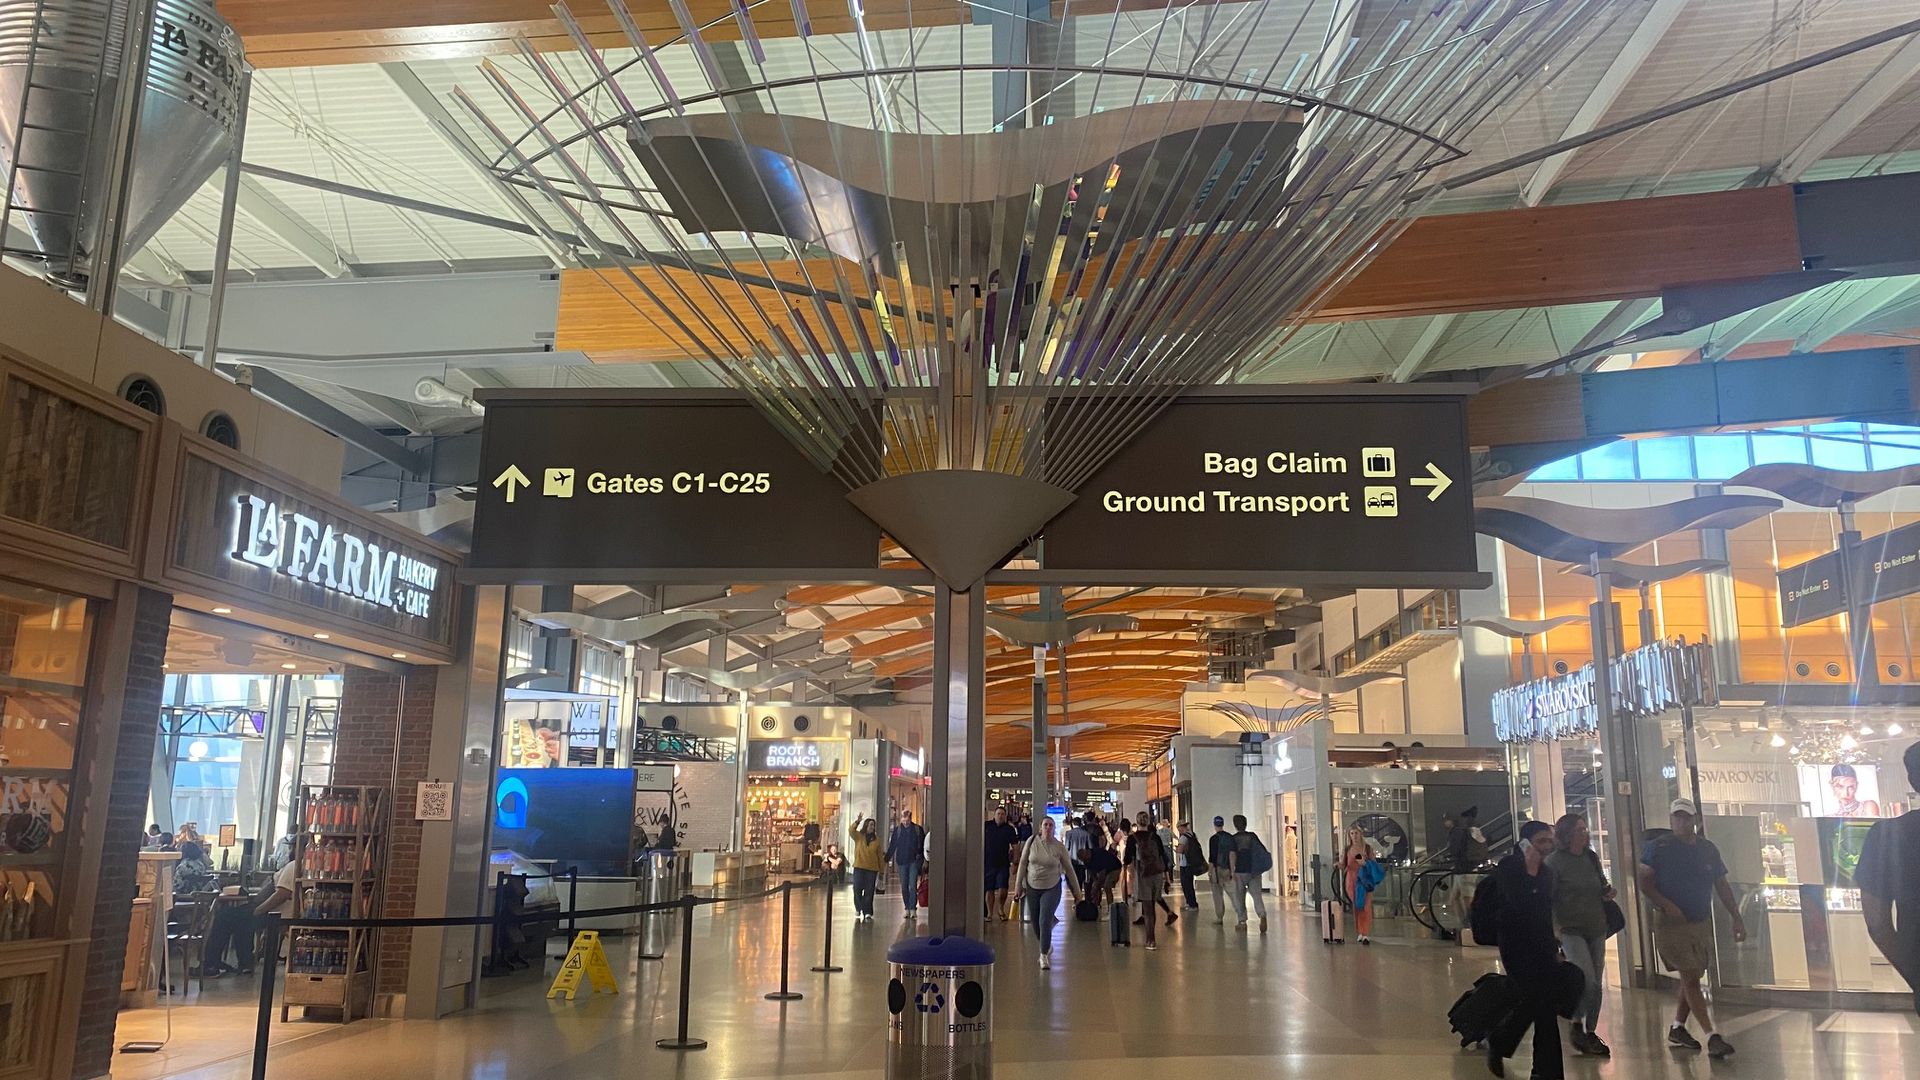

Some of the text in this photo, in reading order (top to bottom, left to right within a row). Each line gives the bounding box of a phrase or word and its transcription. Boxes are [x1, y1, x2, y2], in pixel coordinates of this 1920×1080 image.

[162, 21, 190, 57] LA
[1204, 452, 1347, 479] Bag Claim
[587, 472, 771, 494] Gates C1-C25
[1103, 490, 1350, 517] Ground Transport
[239, 494, 399, 608] LA FARM
[1901, 553, 1916, 565] Enter
[398, 554, 438, 592] BAKERY
[405, 589, 432, 619] CAFE
[1535, 682, 1591, 718] SWAROVSKI
[766, 756, 820, 767] BRANCH
[768, 745, 817, 756] ROOT &
[639, 773, 656, 782] ERE
[901, 968, 966, 980] NEWSPAPERS
[948, 1021, 987, 1033] BOTTLES
